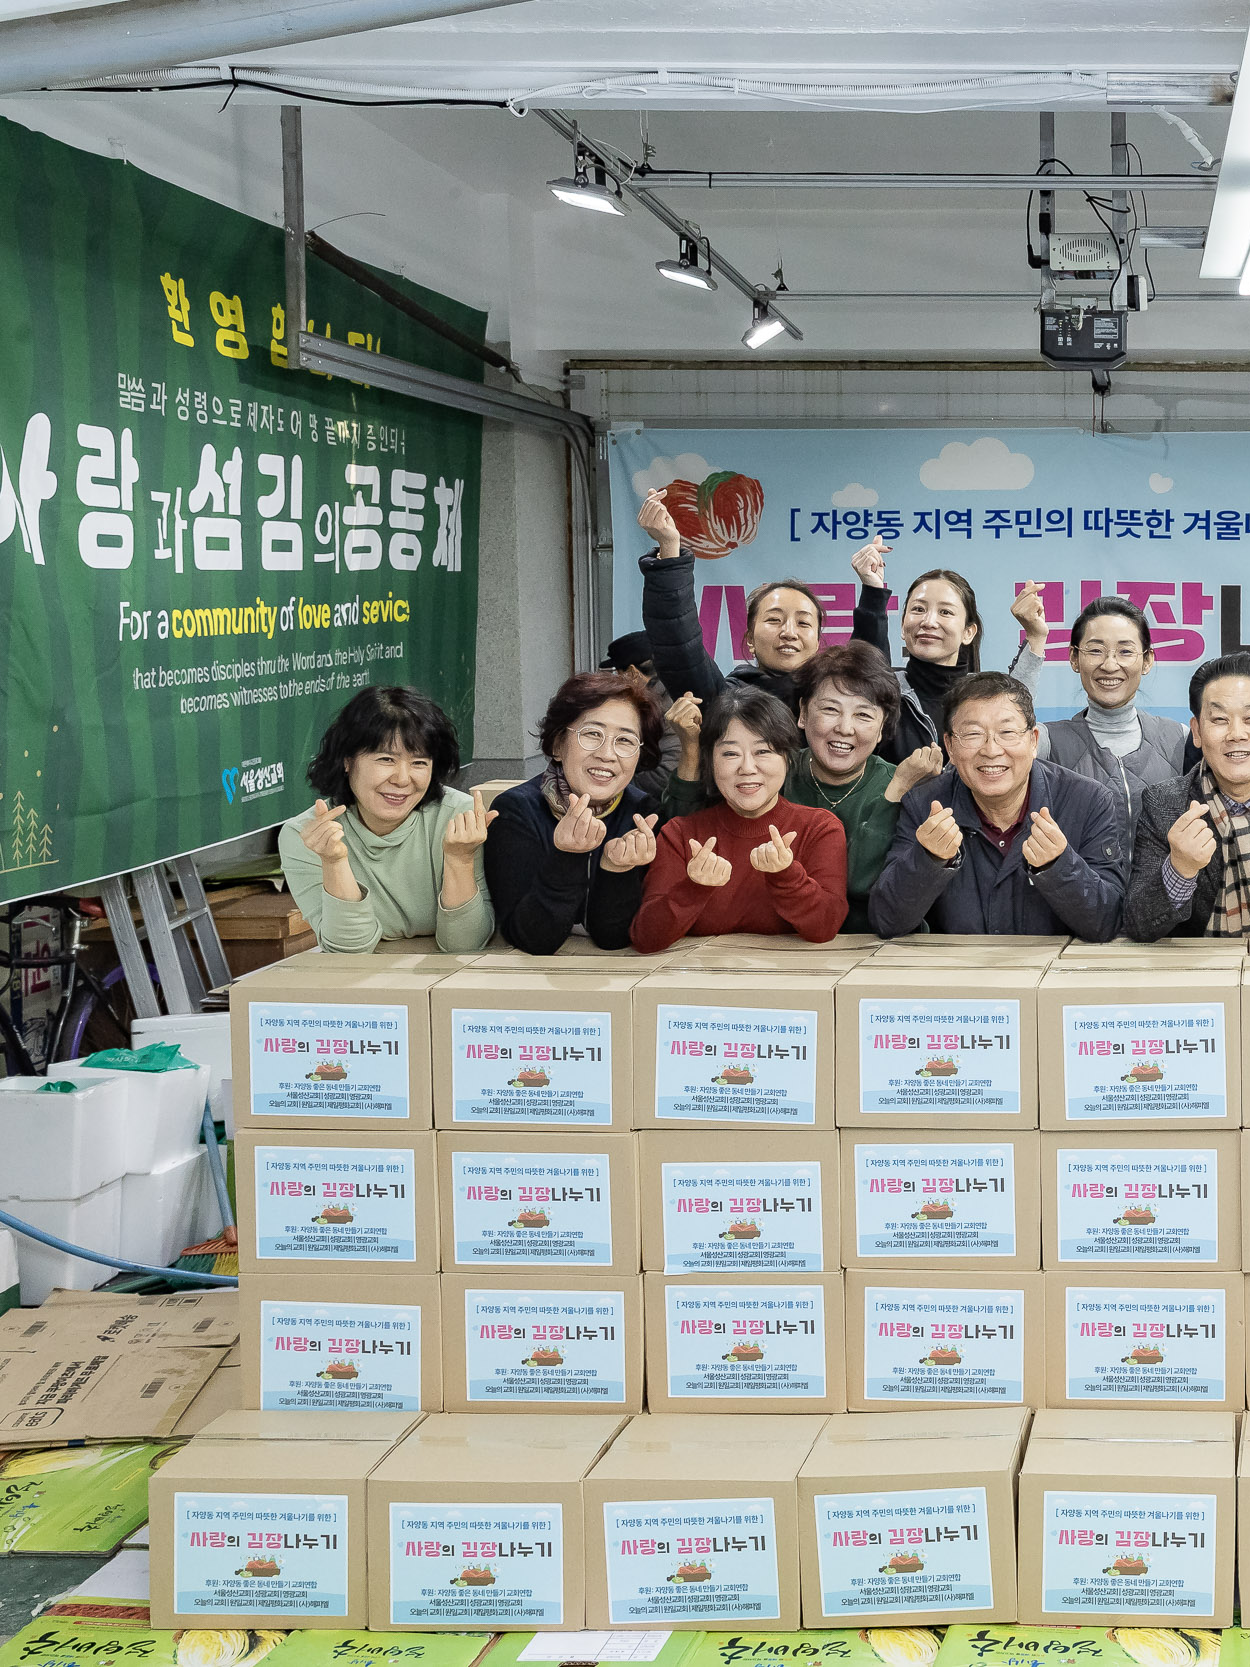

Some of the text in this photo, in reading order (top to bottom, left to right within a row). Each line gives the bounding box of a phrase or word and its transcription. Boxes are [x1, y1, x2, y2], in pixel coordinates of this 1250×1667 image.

[117, 372, 168, 416] 말씀과
[175, 386, 242, 428] 성령으로
[324, 416, 361, 450] 끝까지
[189, 443, 340, 574] 섬김의
[342, 463, 465, 573] 공동체
[810, 508, 904, 541] 자양동
[912, 507, 973, 540] 지역
[982, 507, 1073, 539] 주민의
[1083, 507, 1175, 540] 따뜻한
[119, 601, 153, 642] For
[156, 610, 169, 640] a
[171, 597, 278, 640] community
[279, 596, 296, 632] of
[298, 596, 331, 630] love
[333, 594, 360, 627] and
[132, 667, 157, 690] that
[159, 665, 211, 688] becomes
[210, 658, 256, 683] disciples
[257, 655, 276, 676] thru
[277, 654, 290, 676] the
[291, 651, 316, 671] Word
[316, 651, 333, 669] and
[334, 649, 348, 666] the
[348, 645, 365, 666] Holy
[384, 641, 404, 660] and
[180, 693, 230, 714] becomes
[230, 686, 278, 707] witnesses
[279, 684, 290, 699] to
[288, 681, 304, 698] the
[304, 677, 326, 696] ends
[325, 673, 336, 693] of
[336, 672, 351, 691] the
[1079, 1019, 1209, 1030] 자양동 지역 주민의 따뜻한 겨울나기를 위한
[263, 1038, 399, 1055] 사랑의 김장나누기
[670, 1040, 806, 1060] 사랑의 김장나누기
[873, 1033, 1010, 1051] 사랑의 김장나누기
[1078, 1037, 1215, 1057] 사랑의 김장나누기
[269, 1181, 405, 1198] 사랑의 김장나누기
[869, 1176, 1005, 1194] 사랑의 김장나누기
[680, 1318, 815, 1336] 사랑의 김장나누기
[878, 1323, 1014, 1340] 사랑의 김장나누기
[275, 1336, 411, 1355] 사랑의 김장나누기
[25, 1411, 48, 1427] eats
[191, 1511, 331, 1522] 자양동 지역 주민의 따뜻한 겨울나기를 위한
[189, 1531, 337, 1550] 사랑의 김장나누기
[832, 1523, 978, 1548] 사랑의 김장나누기
[405, 1540, 552, 1559] 사랑의 김장나누기
[968, 1629, 1102, 1657] 절임배추
